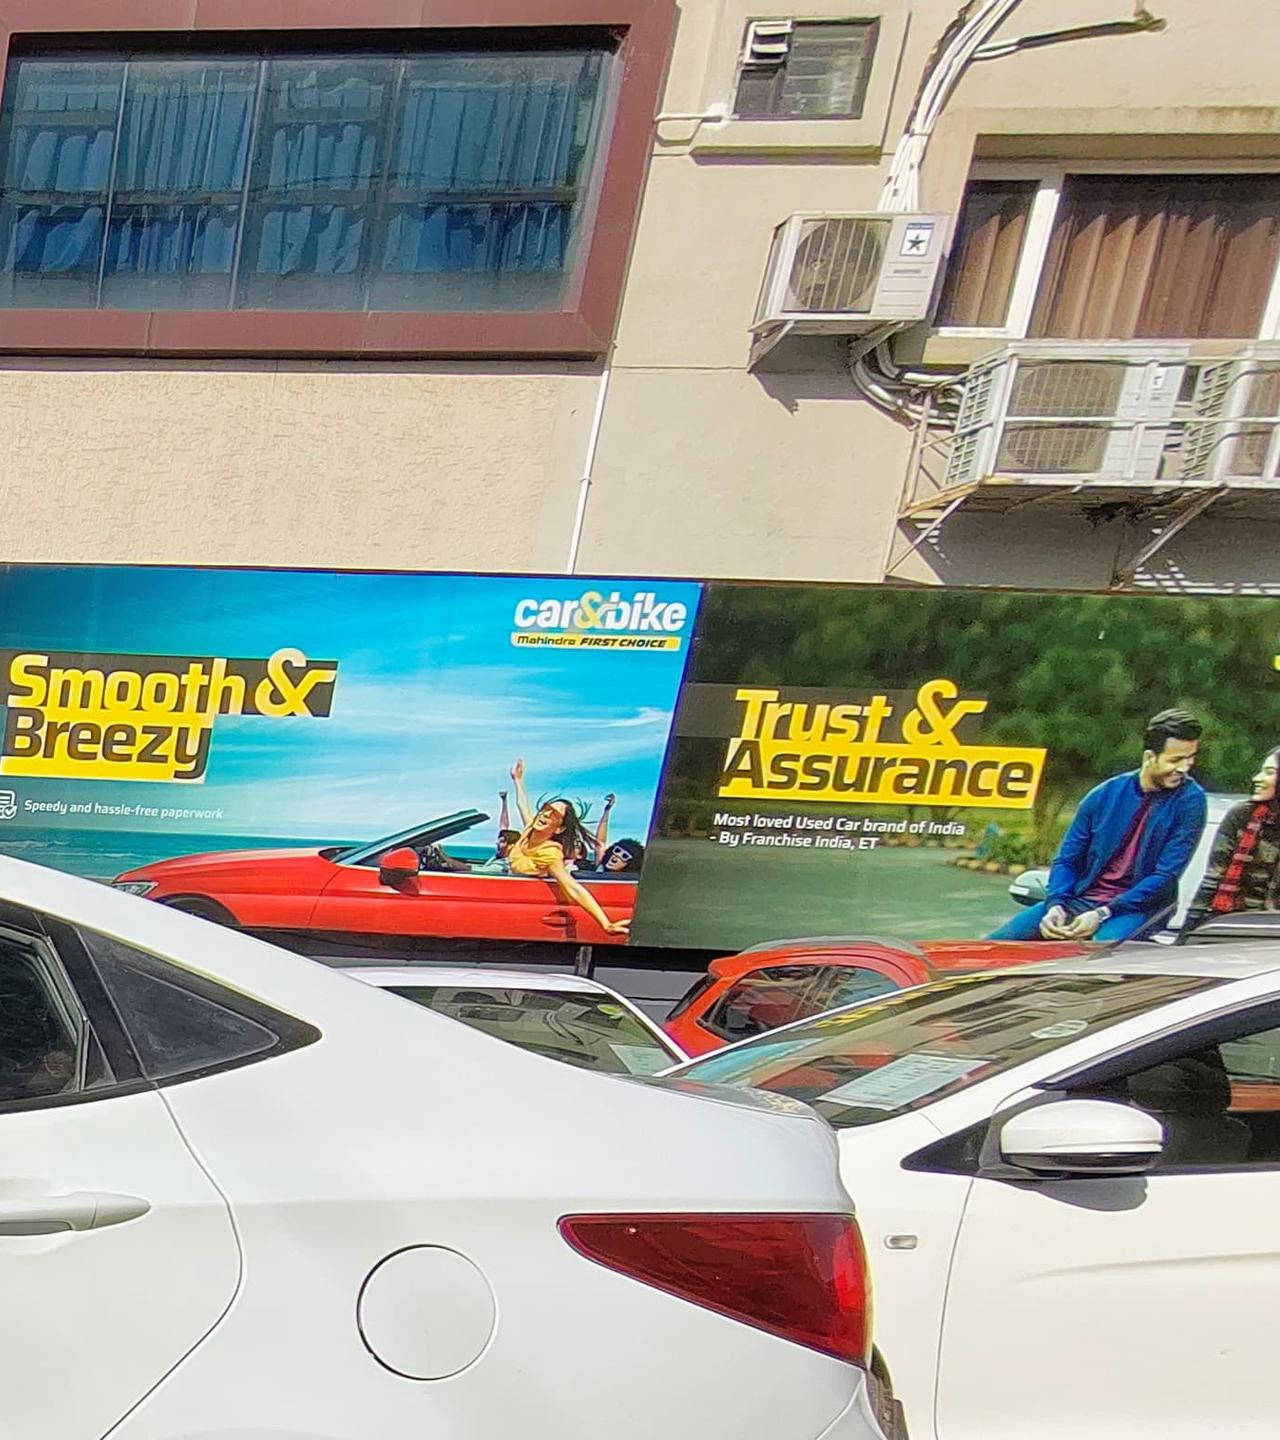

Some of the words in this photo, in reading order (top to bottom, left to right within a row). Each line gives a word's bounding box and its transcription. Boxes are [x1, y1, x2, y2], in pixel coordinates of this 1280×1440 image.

[513, 591, 687, 632] car&bike
[517, 635, 576, 646] Mahindra
[580, 638, 618, 648] FIRST
[619, 638, 667, 648] CHOICE
[7, 652, 246, 716] Smooth
[253, 647, 338, 717] &
[734, 688, 893, 743] Trust
[901, 679, 988, 747] &
[4, 708, 212, 779] Breezy
[719, 738, 1034, 799] Assurance
[24, 799, 67, 815] Speedy
[69, 802, 92, 813] and
[94, 805, 158, 817] hassle-free
[160, 808, 224, 820] paperwork
[713, 813, 751, 828] Most
[753, 815, 791, 829] loved
[795, 816, 834, 830] Used
[836, 818, 861, 831] Car
[863, 819, 906, 833] brand
[909, 820, 927, 834] of
[928, 821, 966, 836] India
[719, 831, 740, 847] By
[742, 832, 812, 847] Franchise
[814, 835, 855, 850] India,
[857, 837, 881, 850] ET
